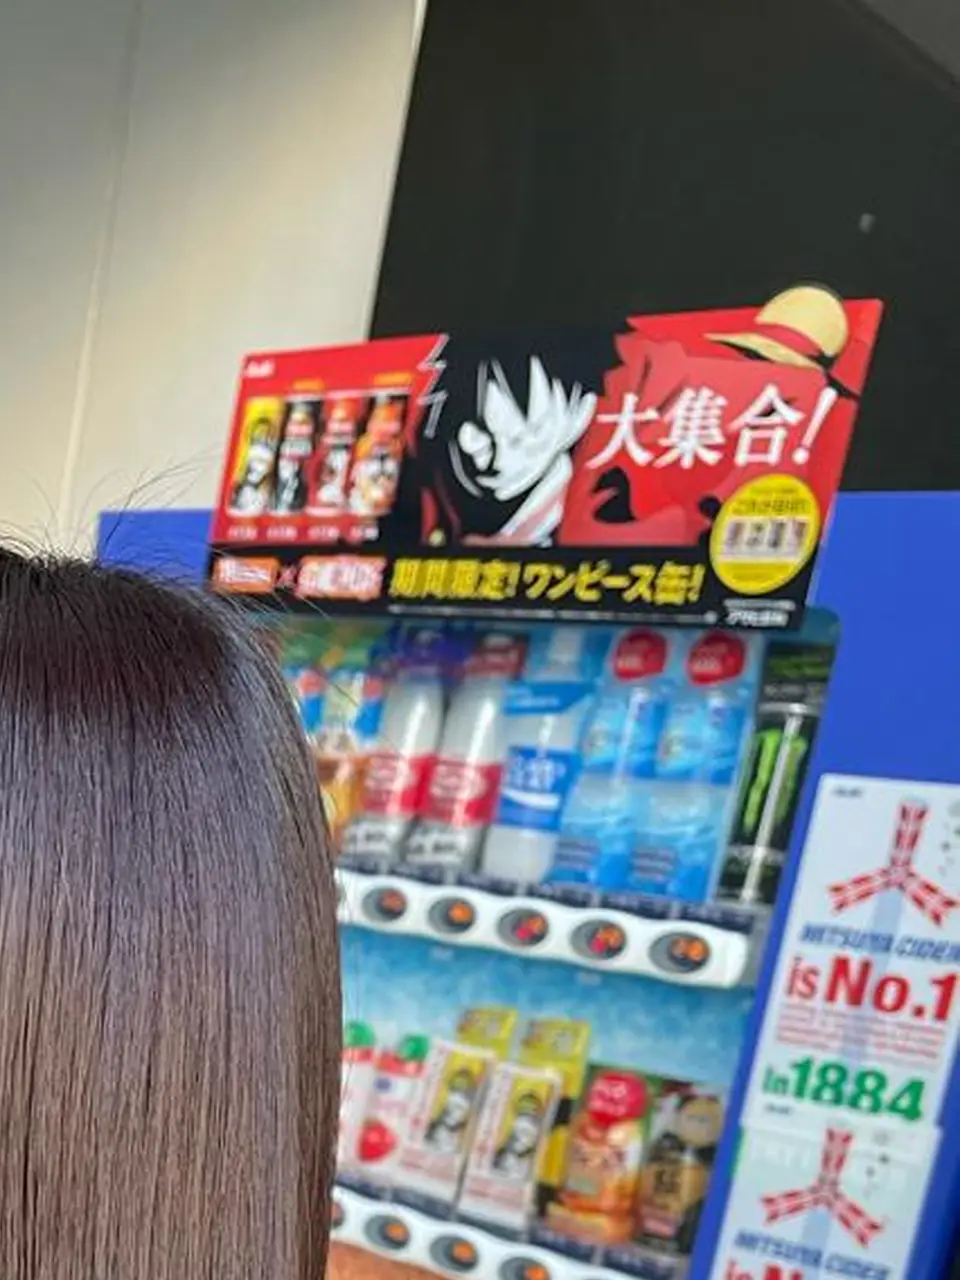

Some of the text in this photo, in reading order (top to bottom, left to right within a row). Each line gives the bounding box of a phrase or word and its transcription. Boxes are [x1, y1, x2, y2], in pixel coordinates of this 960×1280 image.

[586, 384, 838, 469] 大集合!
[824, 954, 958, 1022] No.1
[790, 1055, 925, 1121] 1884
